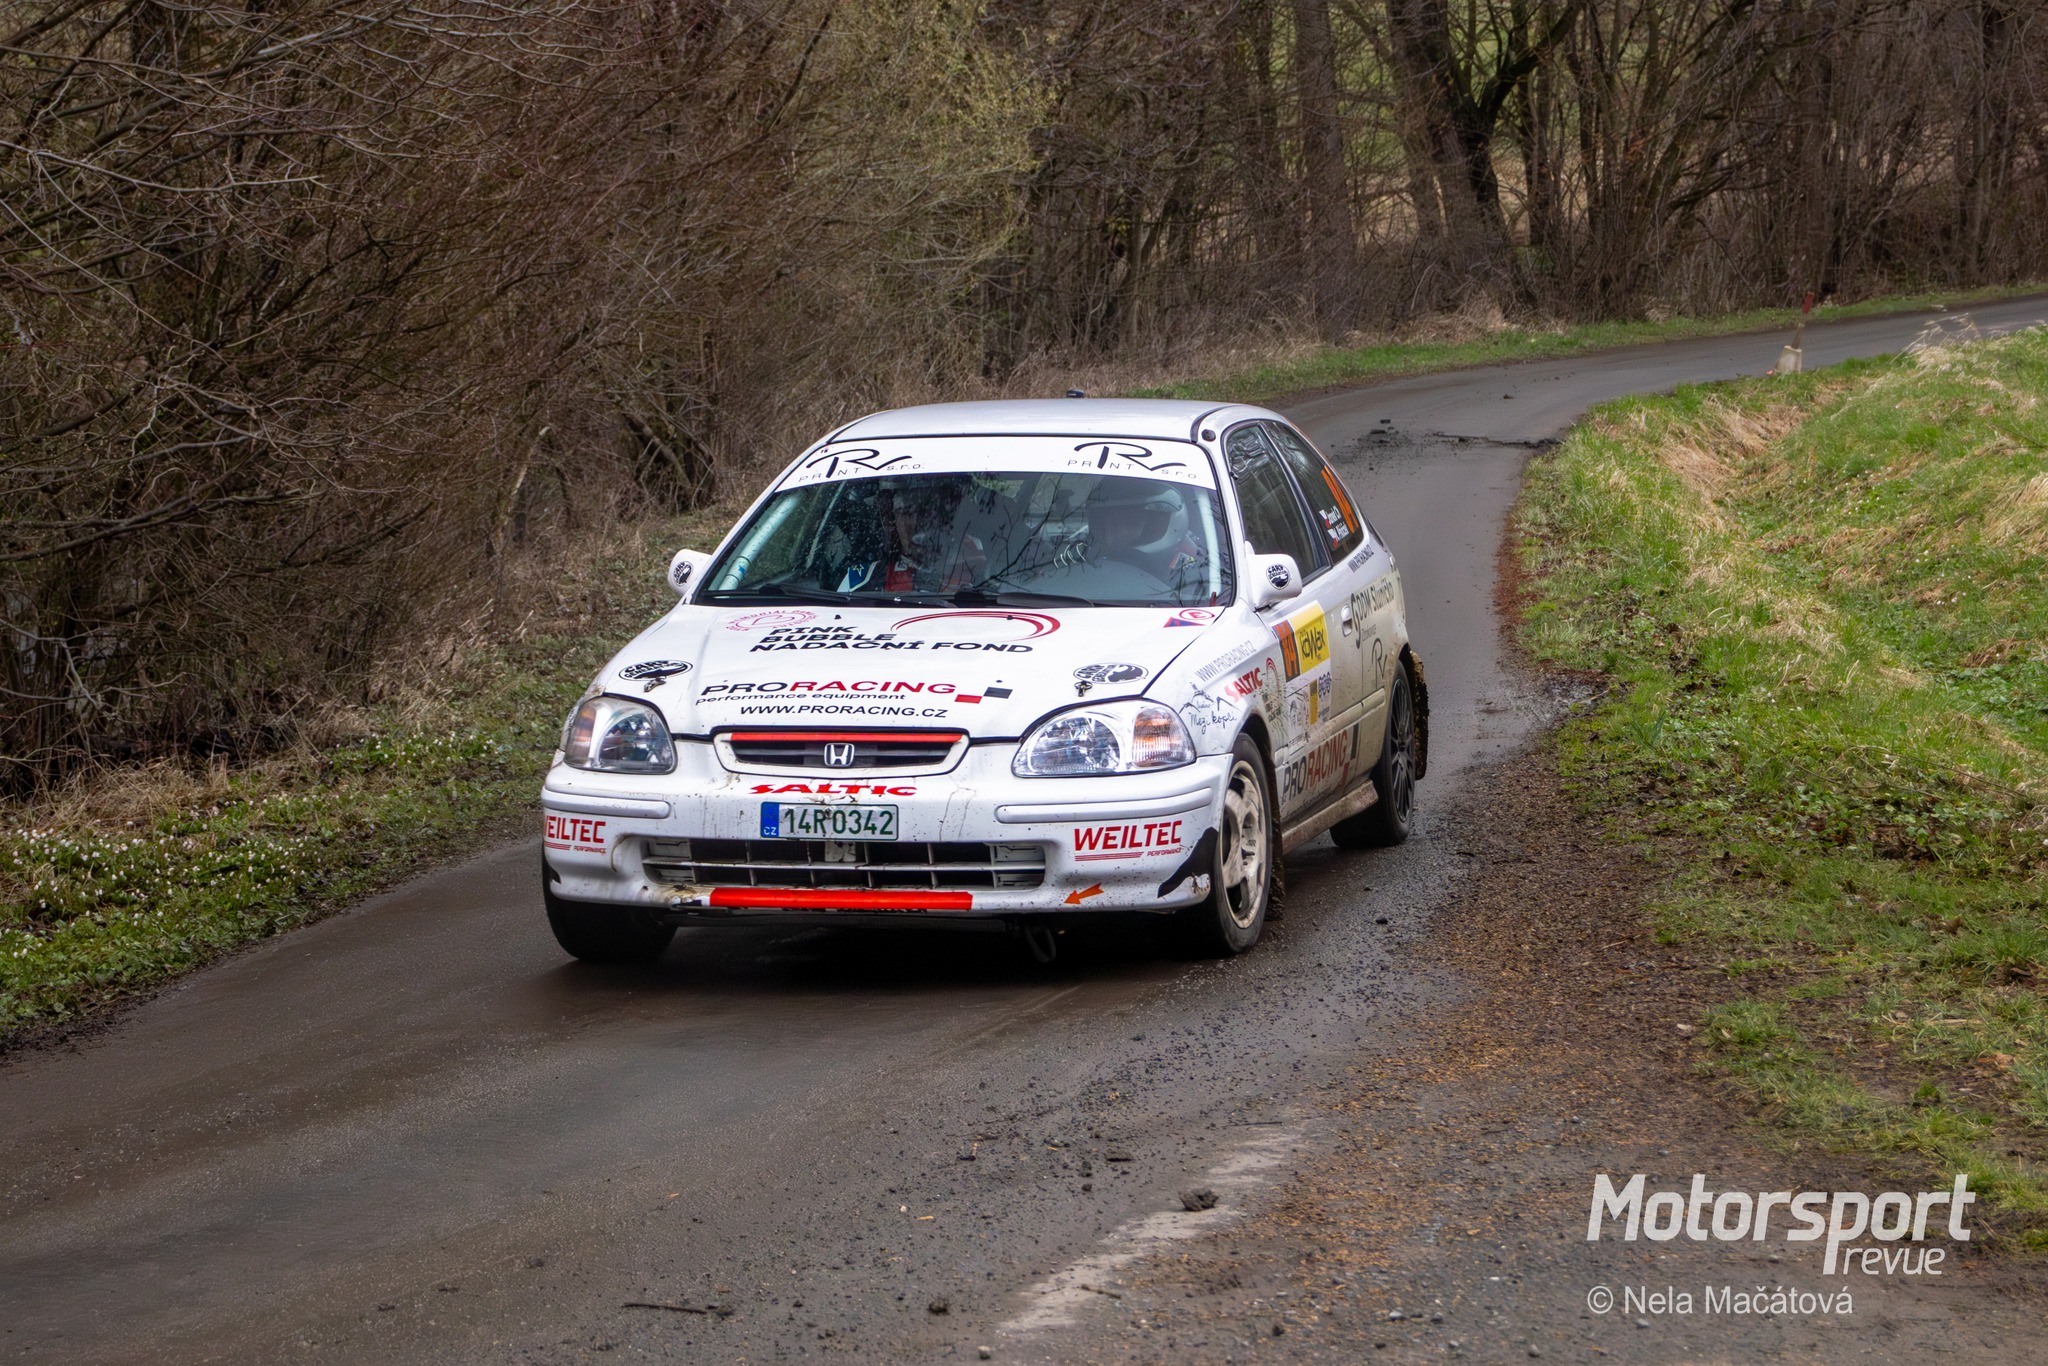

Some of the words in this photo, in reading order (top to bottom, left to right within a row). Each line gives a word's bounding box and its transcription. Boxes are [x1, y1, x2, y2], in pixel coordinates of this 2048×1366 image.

[769, 626, 858, 635] PINK
[759, 633, 897, 643] BUBBLE
[750, 640, 924, 652] NADAČNÍ
[931, 642, 1033, 653] FOND
[1194, 640, 1257, 682] WWW.PRORACING.CZ
[701, 681, 956, 695] PRORACING
[1224, 667, 1263, 702] SALTIC
[696, 693, 806, 706] performance
[741, 705, 948, 718] WWW.PRORACING.CZ
[1282, 730, 1348, 802] PRORACING
[749, 784, 918, 796] SALTIC
[544, 815, 606, 844] EILTEC
[764, 826, 777, 836] CZ
[1074, 820, 1182, 851] WEILTEC
